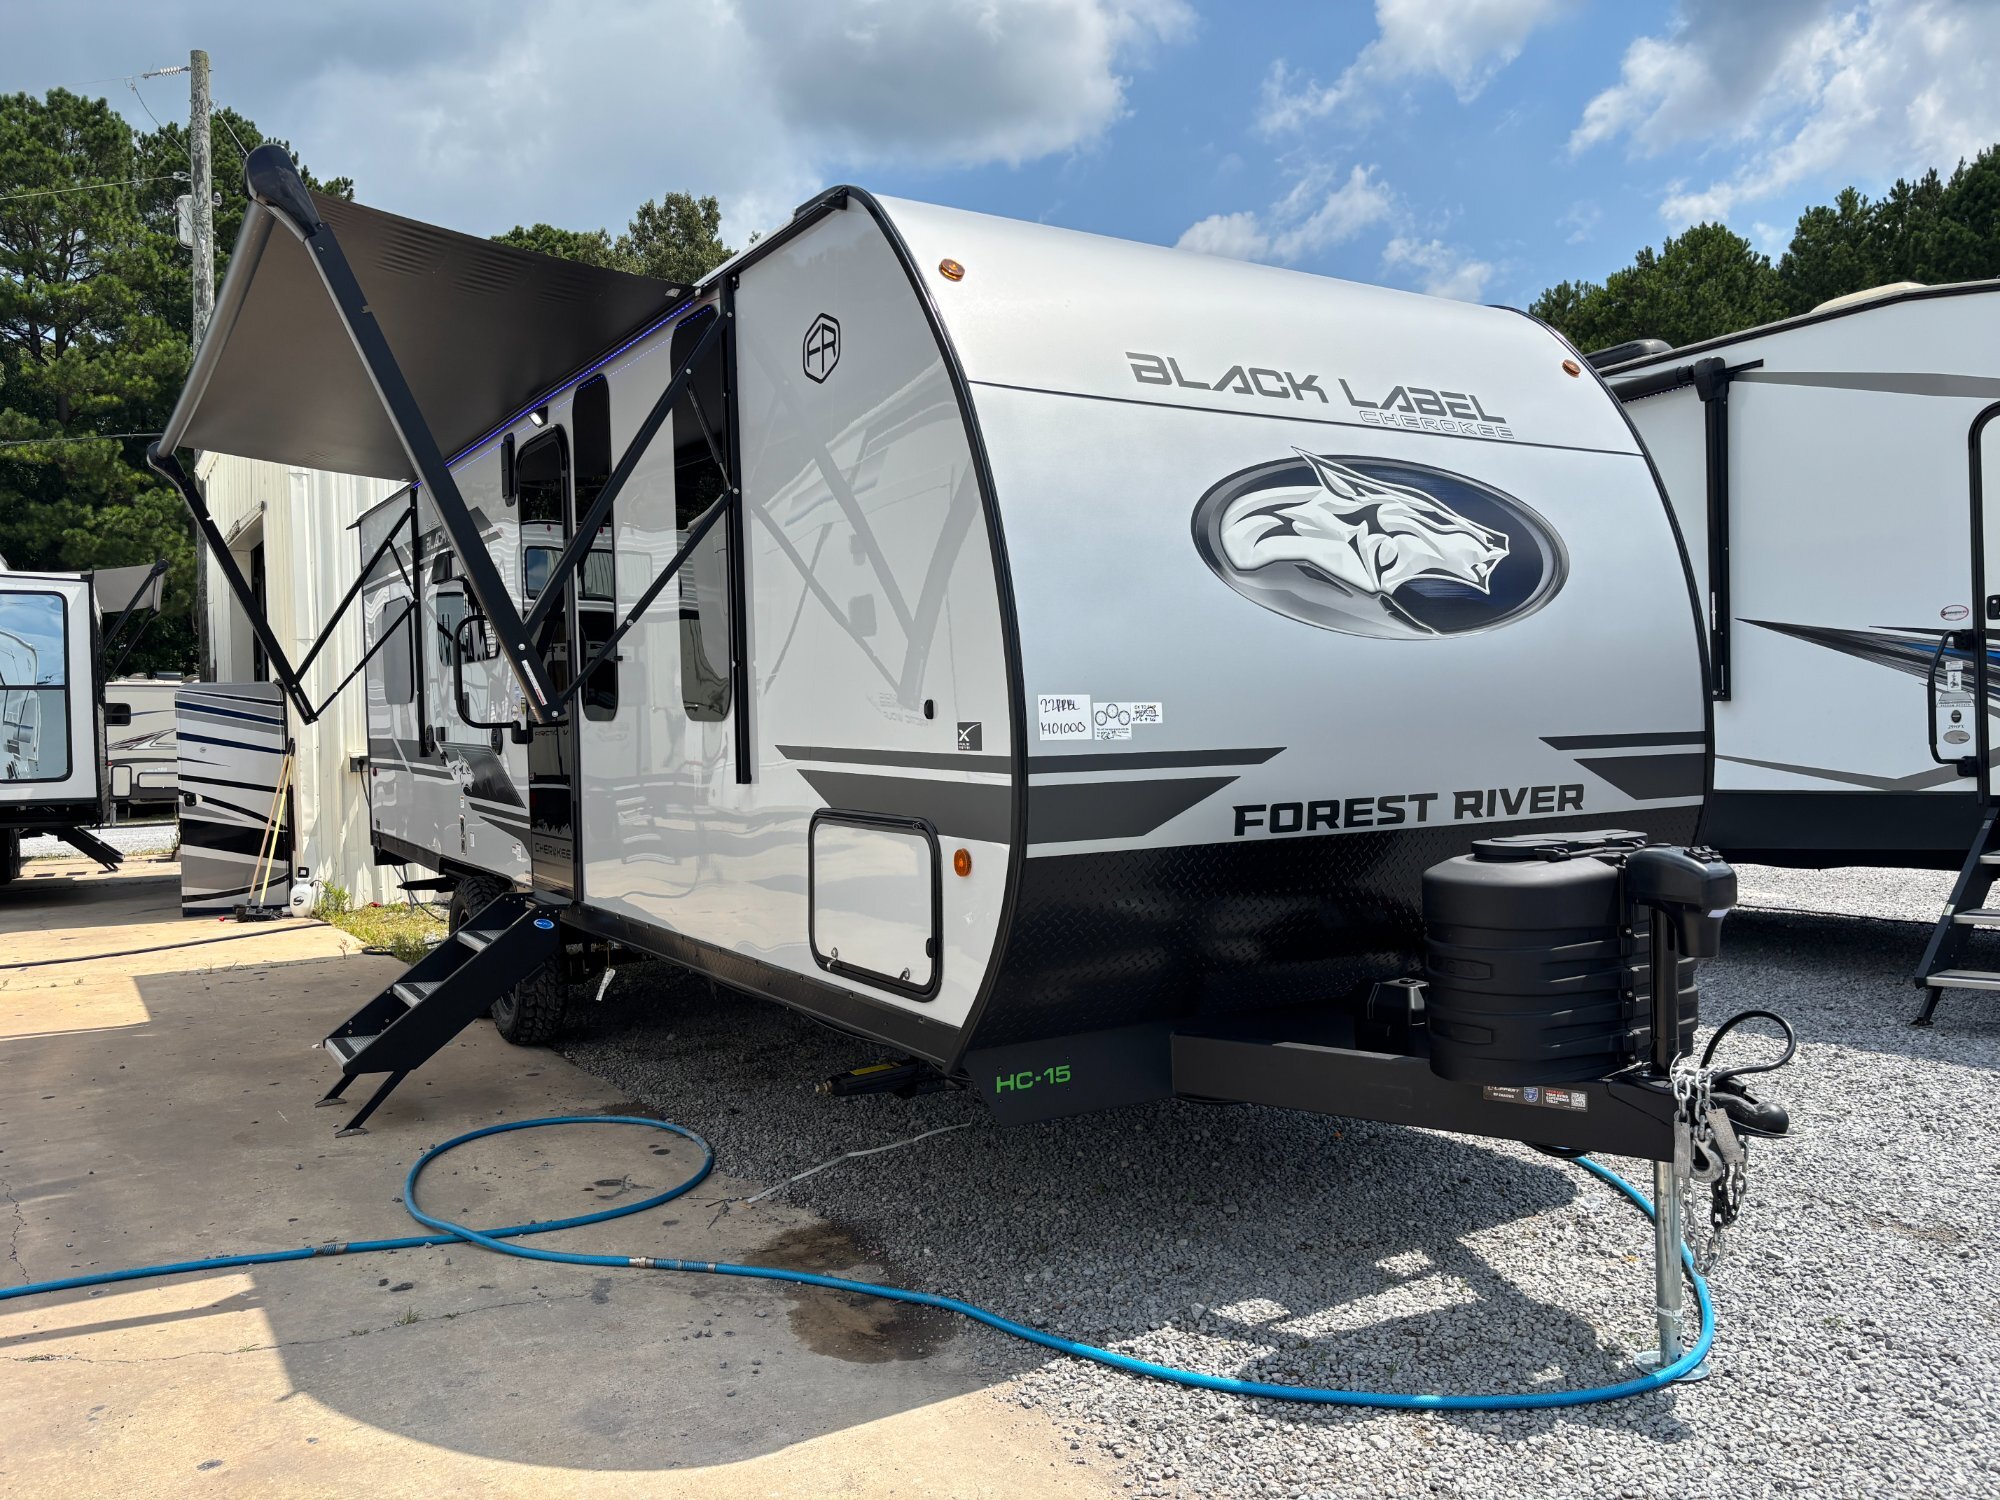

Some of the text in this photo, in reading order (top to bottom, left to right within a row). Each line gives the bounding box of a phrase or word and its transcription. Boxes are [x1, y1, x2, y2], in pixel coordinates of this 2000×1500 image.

[1125, 351, 1507, 424] BLACK LABEL
[1359, 410, 1515, 440] CHEROKEE
[1232, 783, 1585, 837] FOREST RIVER
[996, 1065, 1071, 1093] HC-15
